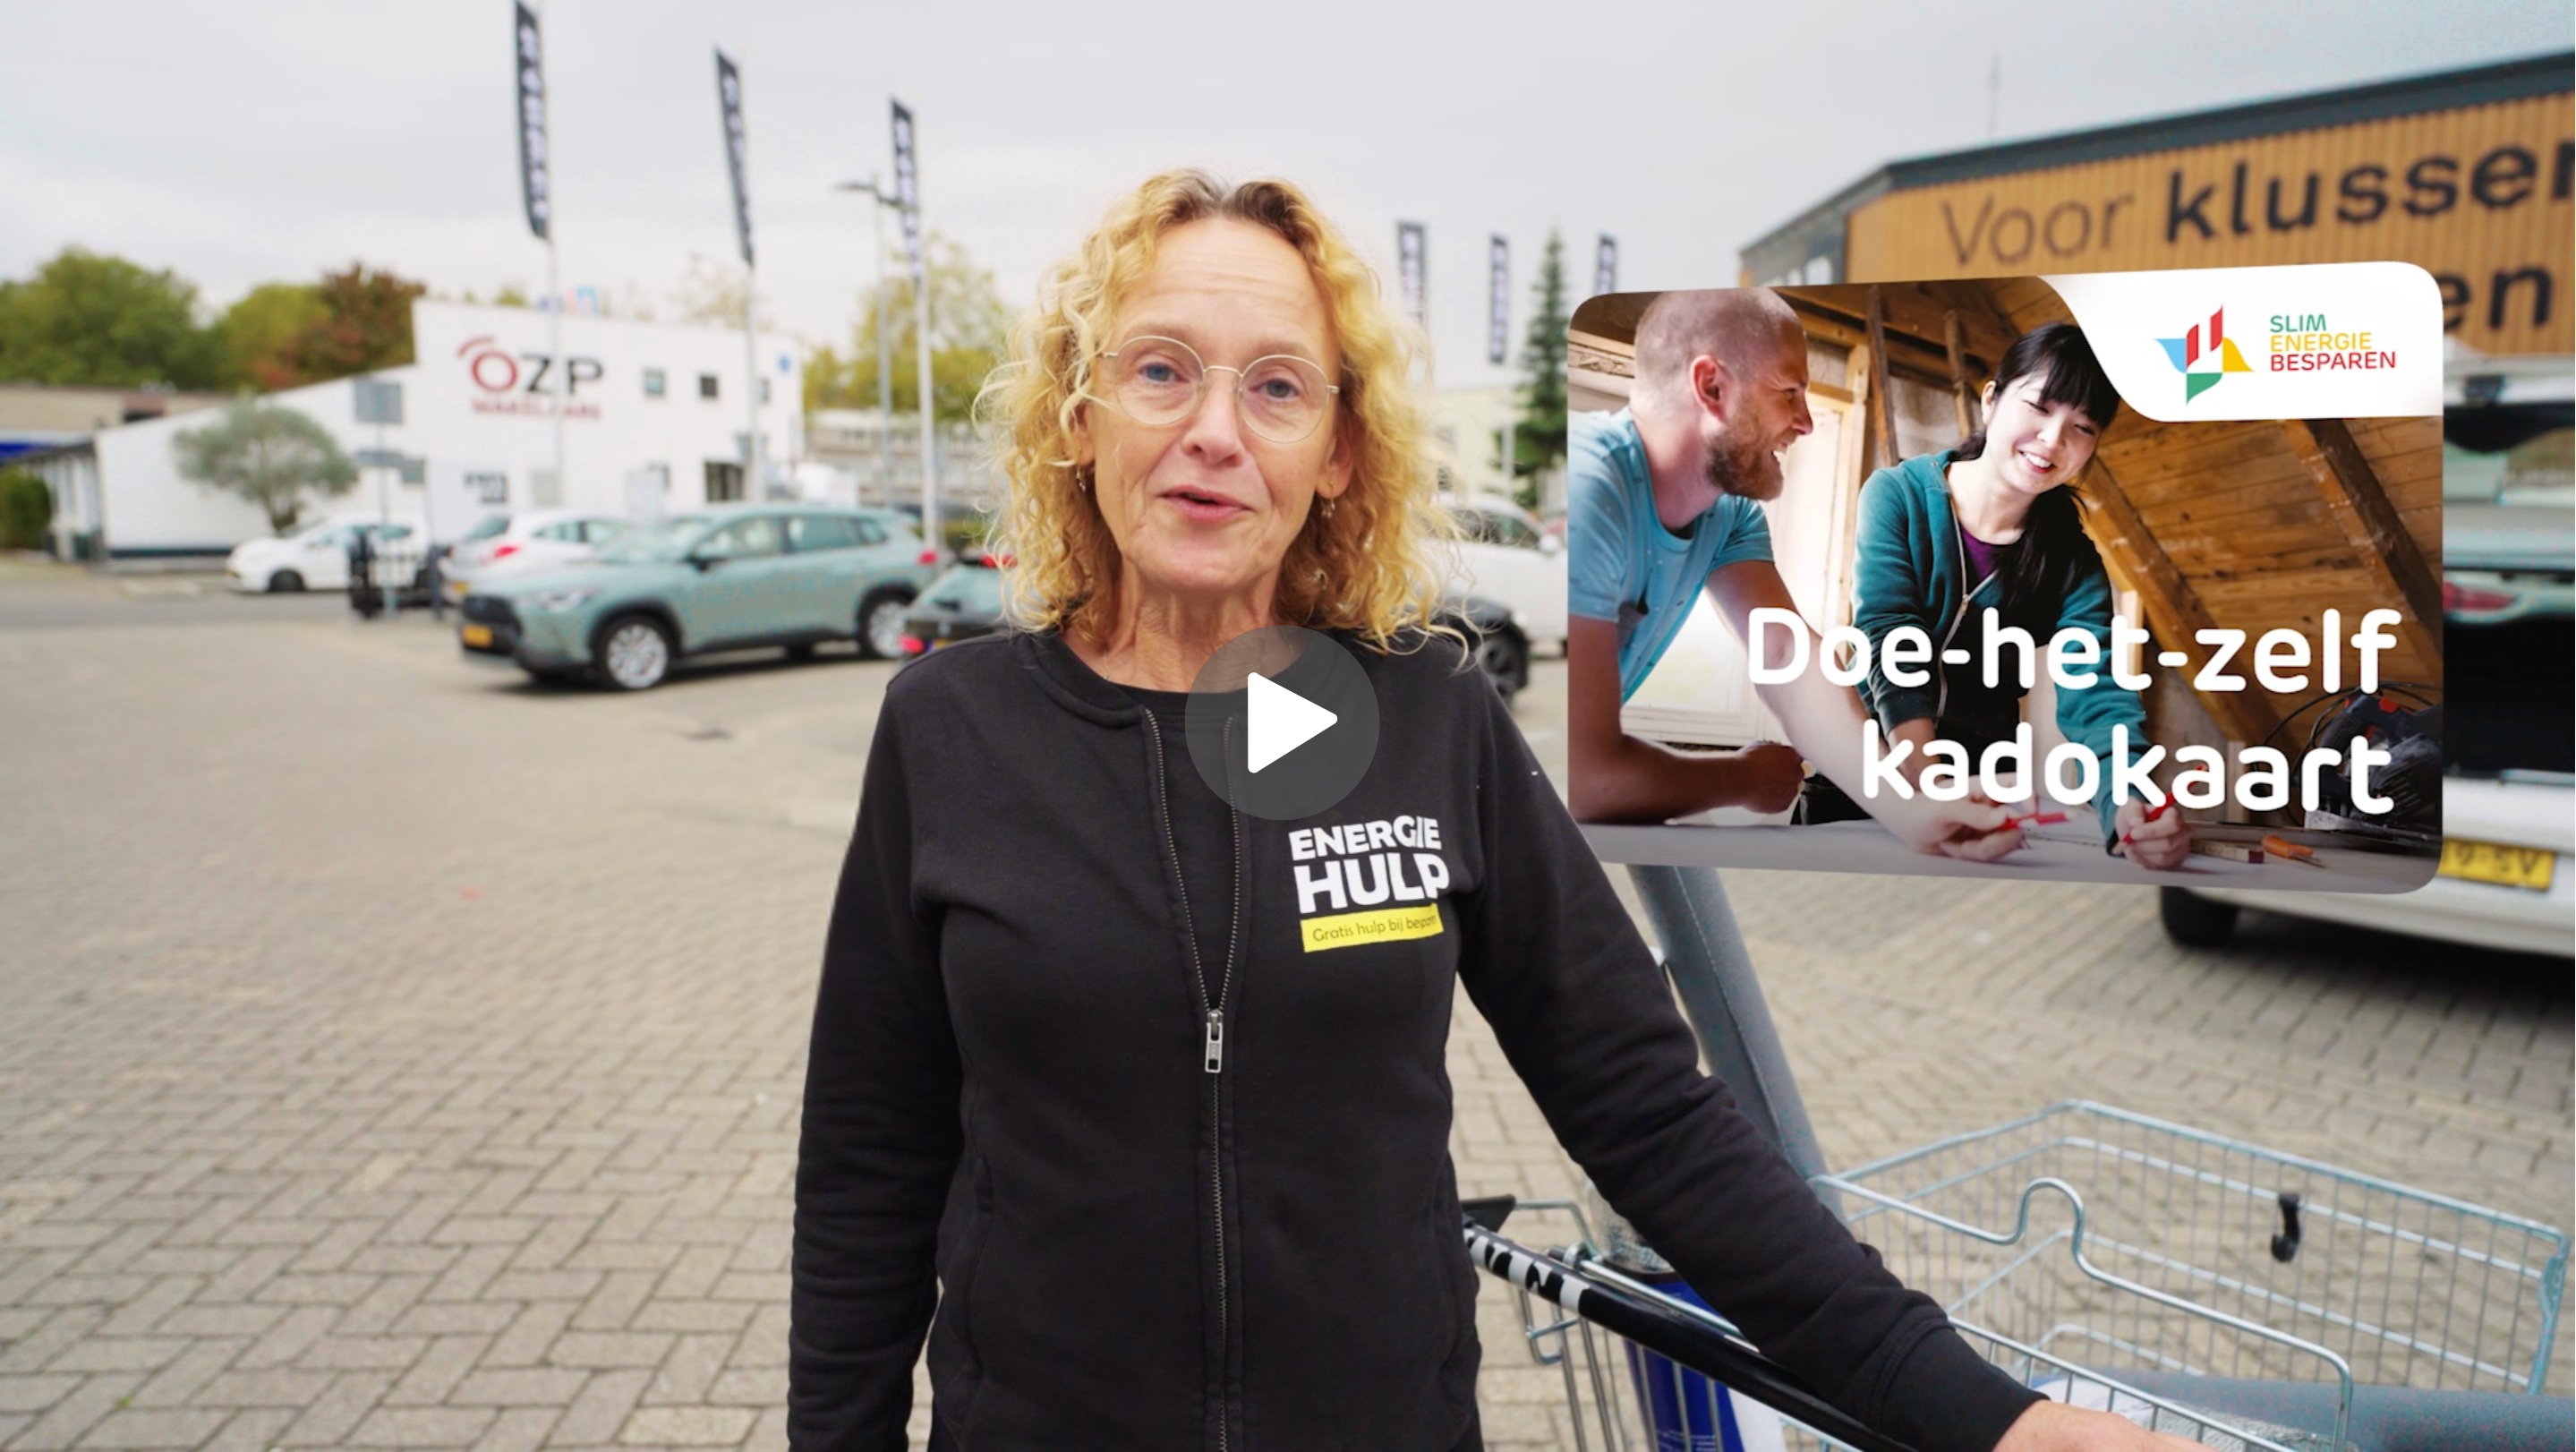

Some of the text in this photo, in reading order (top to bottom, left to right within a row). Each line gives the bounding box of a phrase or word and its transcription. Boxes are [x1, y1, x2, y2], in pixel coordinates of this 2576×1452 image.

[1941, 192, 2136, 266] Voor
[470, 349, 603, 395] OZP
[1288, 815, 1443, 861] ENERGIE
[1293, 851, 1450, 914] HULP
[1312, 926, 1354, 942] Gratis
[1356, 919, 1386, 935] hulp
[1387, 917, 1404, 933] bij
